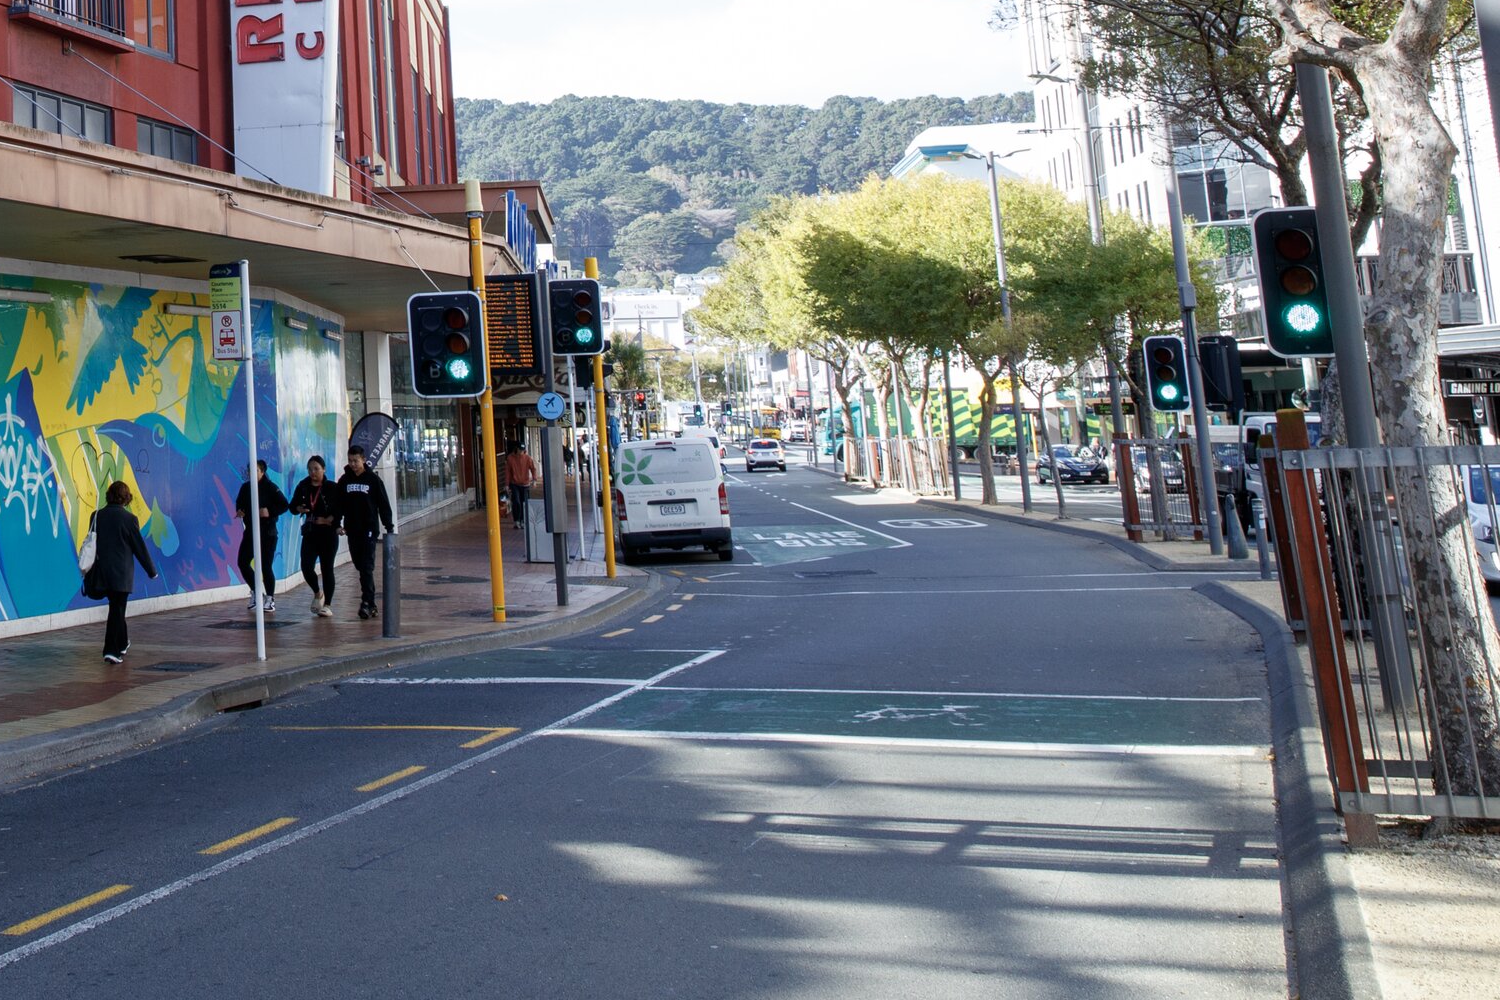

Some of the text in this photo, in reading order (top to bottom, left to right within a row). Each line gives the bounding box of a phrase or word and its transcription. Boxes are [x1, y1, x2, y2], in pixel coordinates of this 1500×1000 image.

[1450, 382, 1488, 394] GAMING
[753, 530, 866, 541] LANE
[774, 538, 868, 548] BUS
